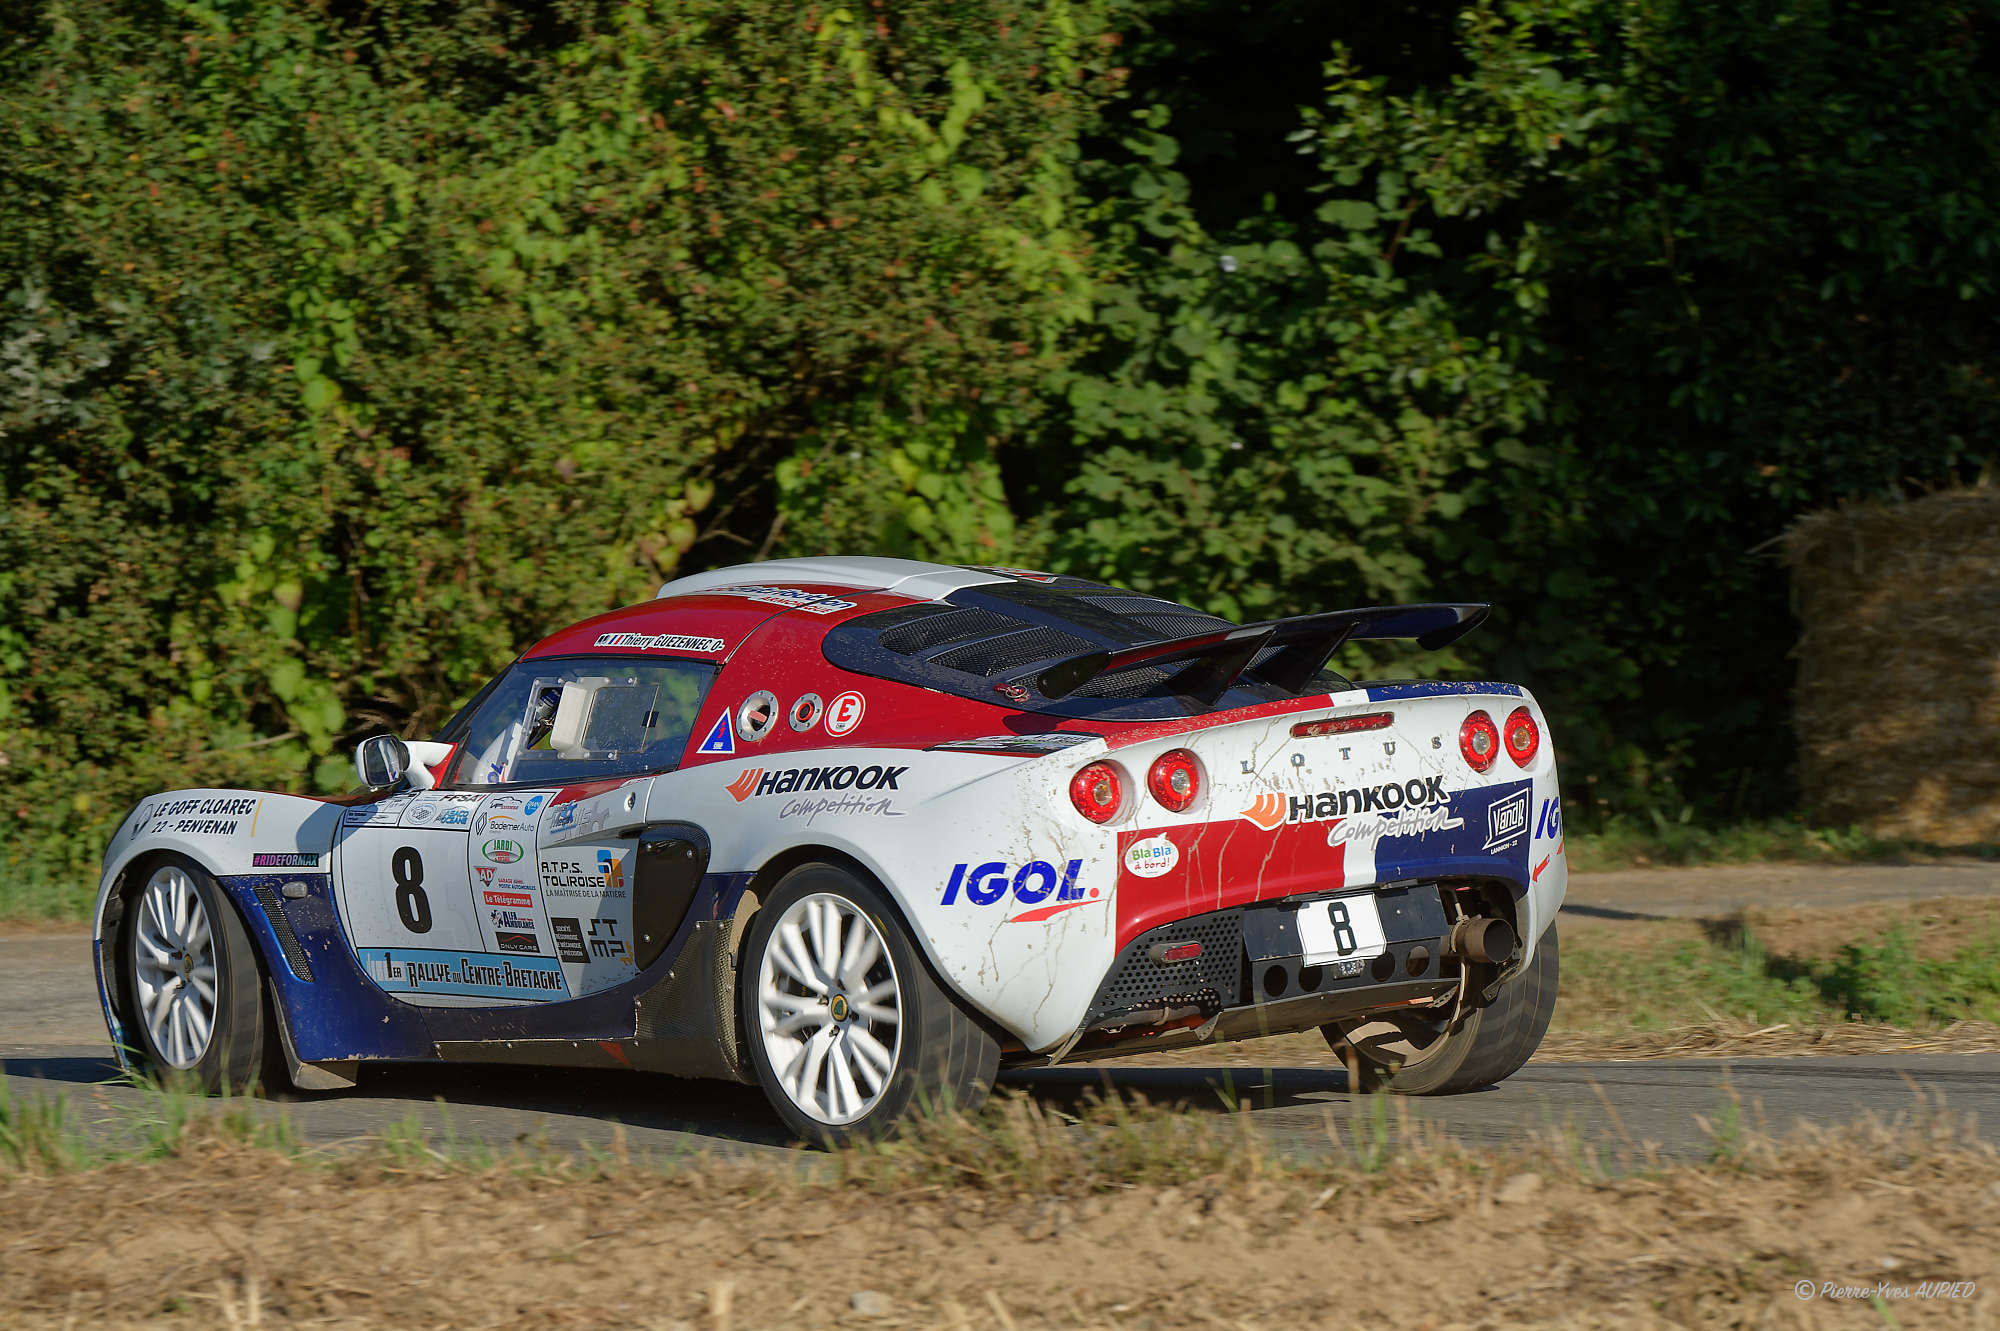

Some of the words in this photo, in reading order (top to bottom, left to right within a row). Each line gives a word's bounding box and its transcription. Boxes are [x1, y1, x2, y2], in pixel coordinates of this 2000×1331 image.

[621, 634, 654, 649] Thierry
[654, 635, 712, 650] GUEZENNEC
[837, 698, 856, 722] E
[1241, 736, 1442, 774] LOTUS
[153, 802, 171, 818] LE
[168, 799, 202, 816] GOFF
[200, 798, 257, 816] CLOAREC
[1535, 796, 1562, 840] IG
[151, 820, 169, 834] 22
[174, 819, 238, 835] PENVENAN
[253, 853, 318, 867] #RIDEFORMAX
[541, 861, 583, 874] A.T.P.S.
[1144, 856, 1170, 869] bord!
[480, 869, 493, 881] AD
[391, 846, 433, 935] 8
[546, 889, 554, 897] LA
[583, 890, 590, 898] DE
[591, 890, 599, 898] LA
[484, 894, 493, 903] Le
[493, 894, 531, 906] Télégramme
[1327, 901, 1358, 957] 8
[406, 962, 452, 988] RALLYE
[460, 957, 562, 990] CENTRE-BRETAGNE
